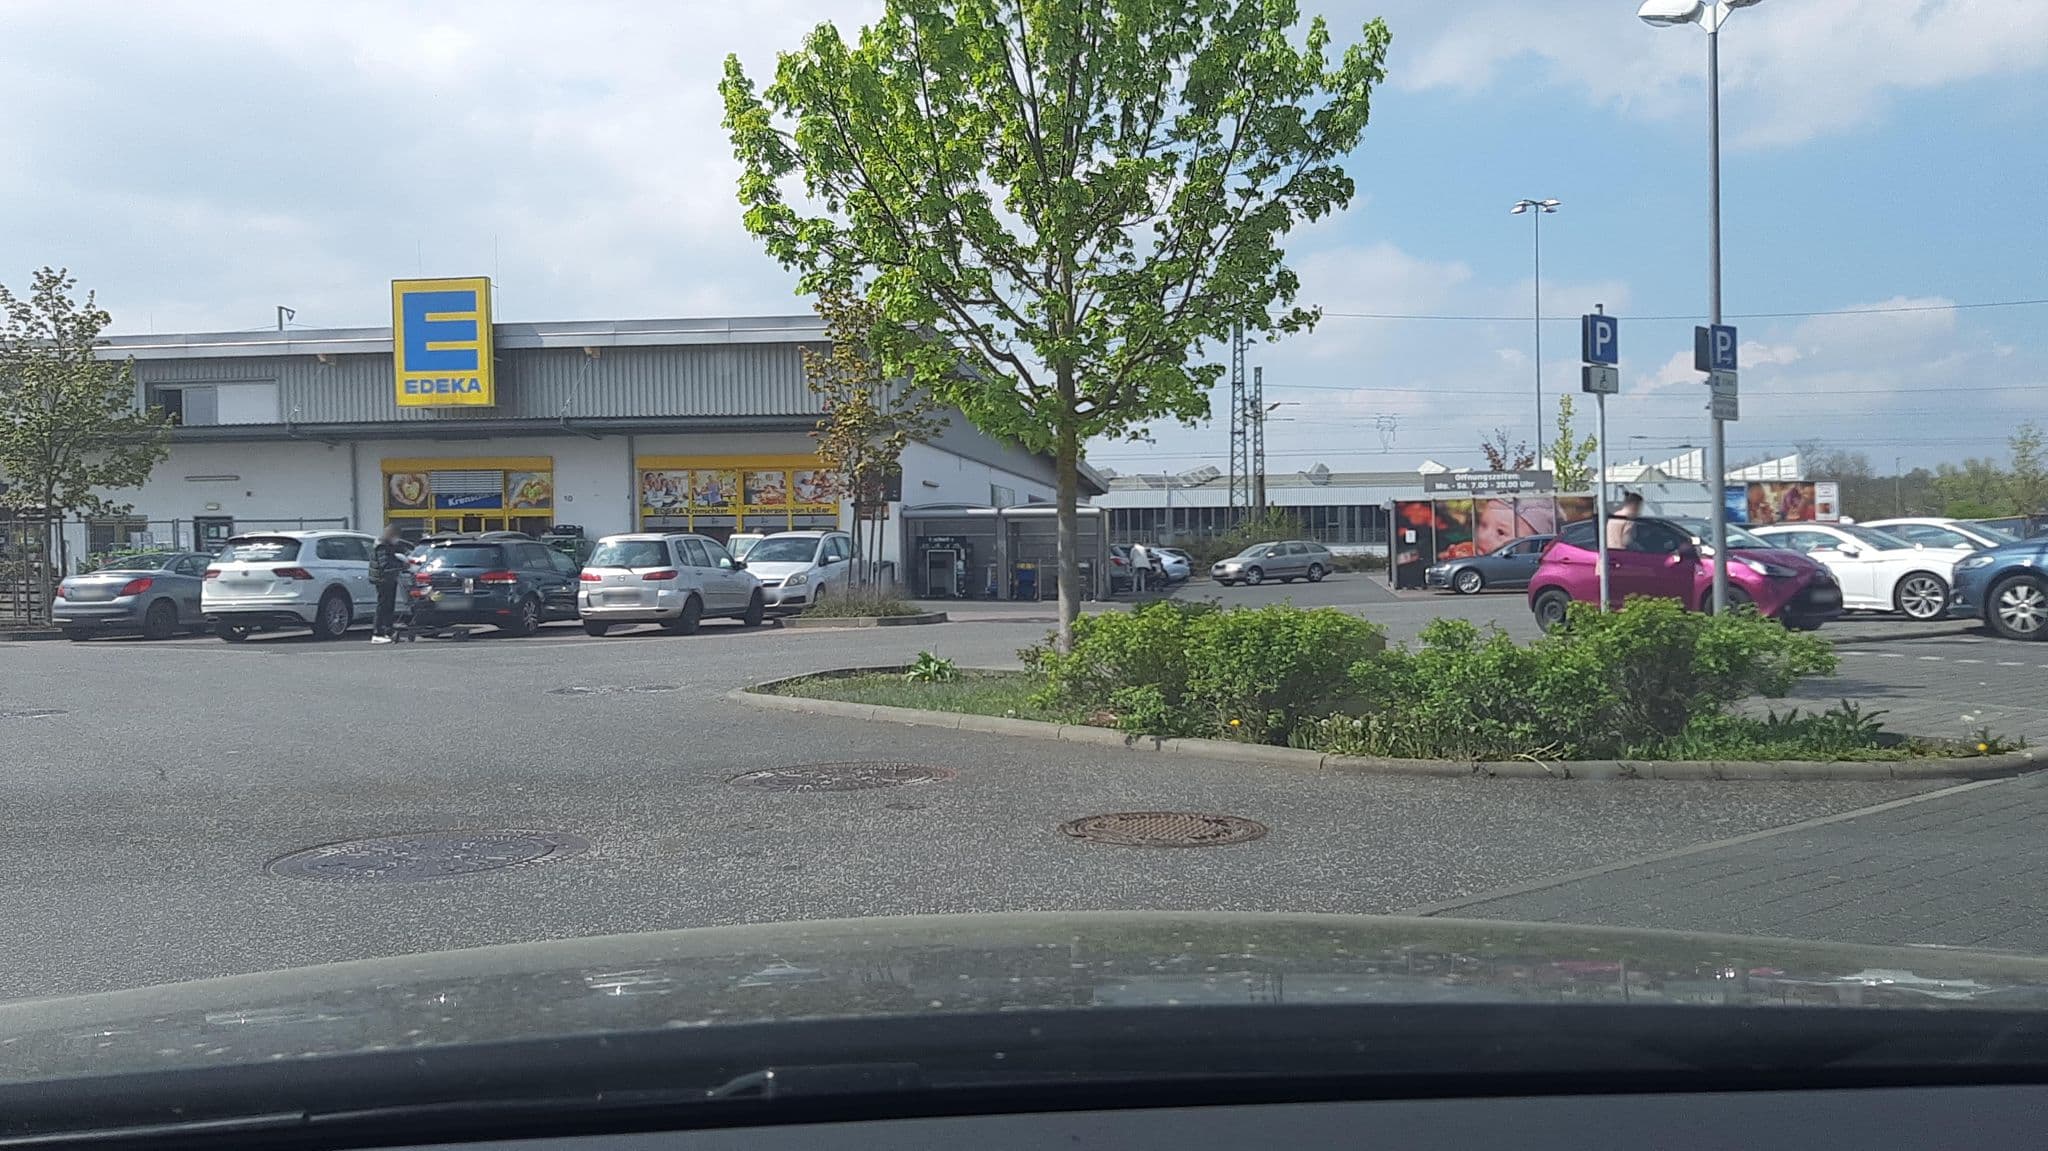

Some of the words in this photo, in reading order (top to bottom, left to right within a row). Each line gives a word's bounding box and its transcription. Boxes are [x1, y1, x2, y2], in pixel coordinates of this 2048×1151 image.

[402, 290, 478, 372] E
[1595, 321, 1612, 357] P
[1716, 331, 1731, 363] P
[404, 378, 481, 394] EDEKA
